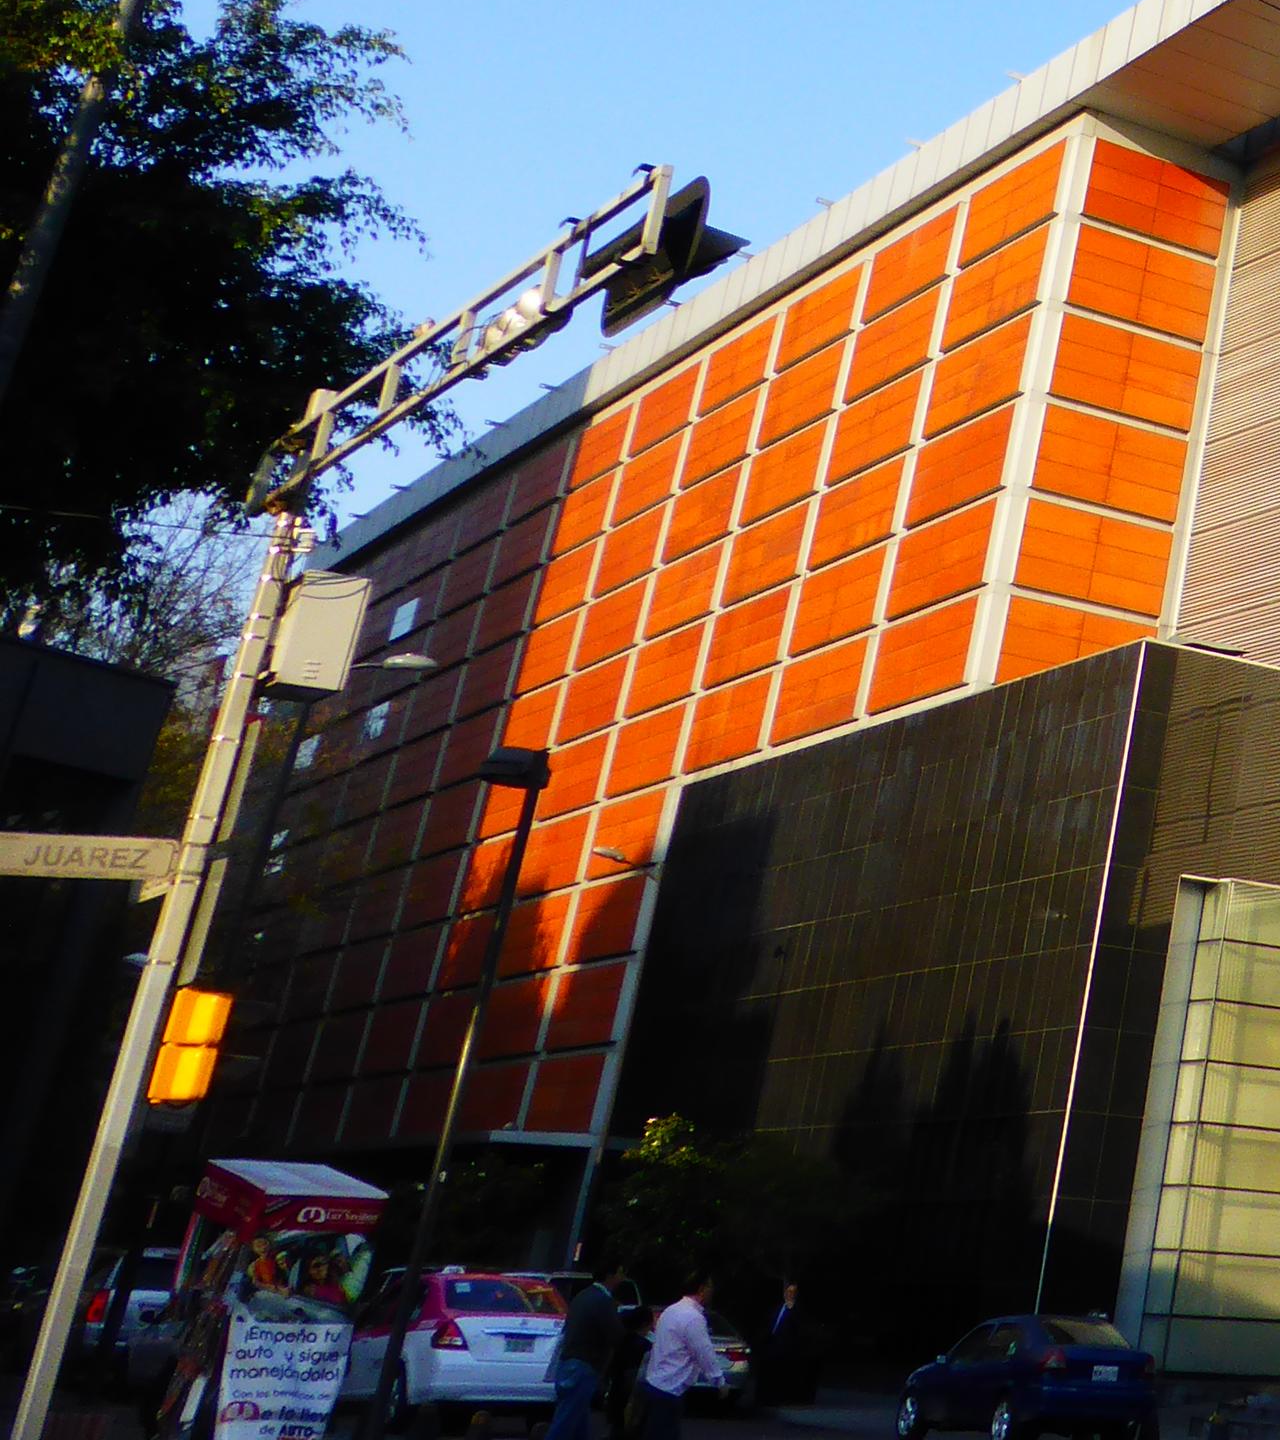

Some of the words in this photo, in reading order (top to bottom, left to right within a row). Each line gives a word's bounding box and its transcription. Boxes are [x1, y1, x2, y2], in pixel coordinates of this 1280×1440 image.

[23, 844, 150, 870] JUAREZ
[235, 1346, 273, 1360] auto
[284, 1351, 294, 1363] y
[299, 1348, 339, 1365] sigue
